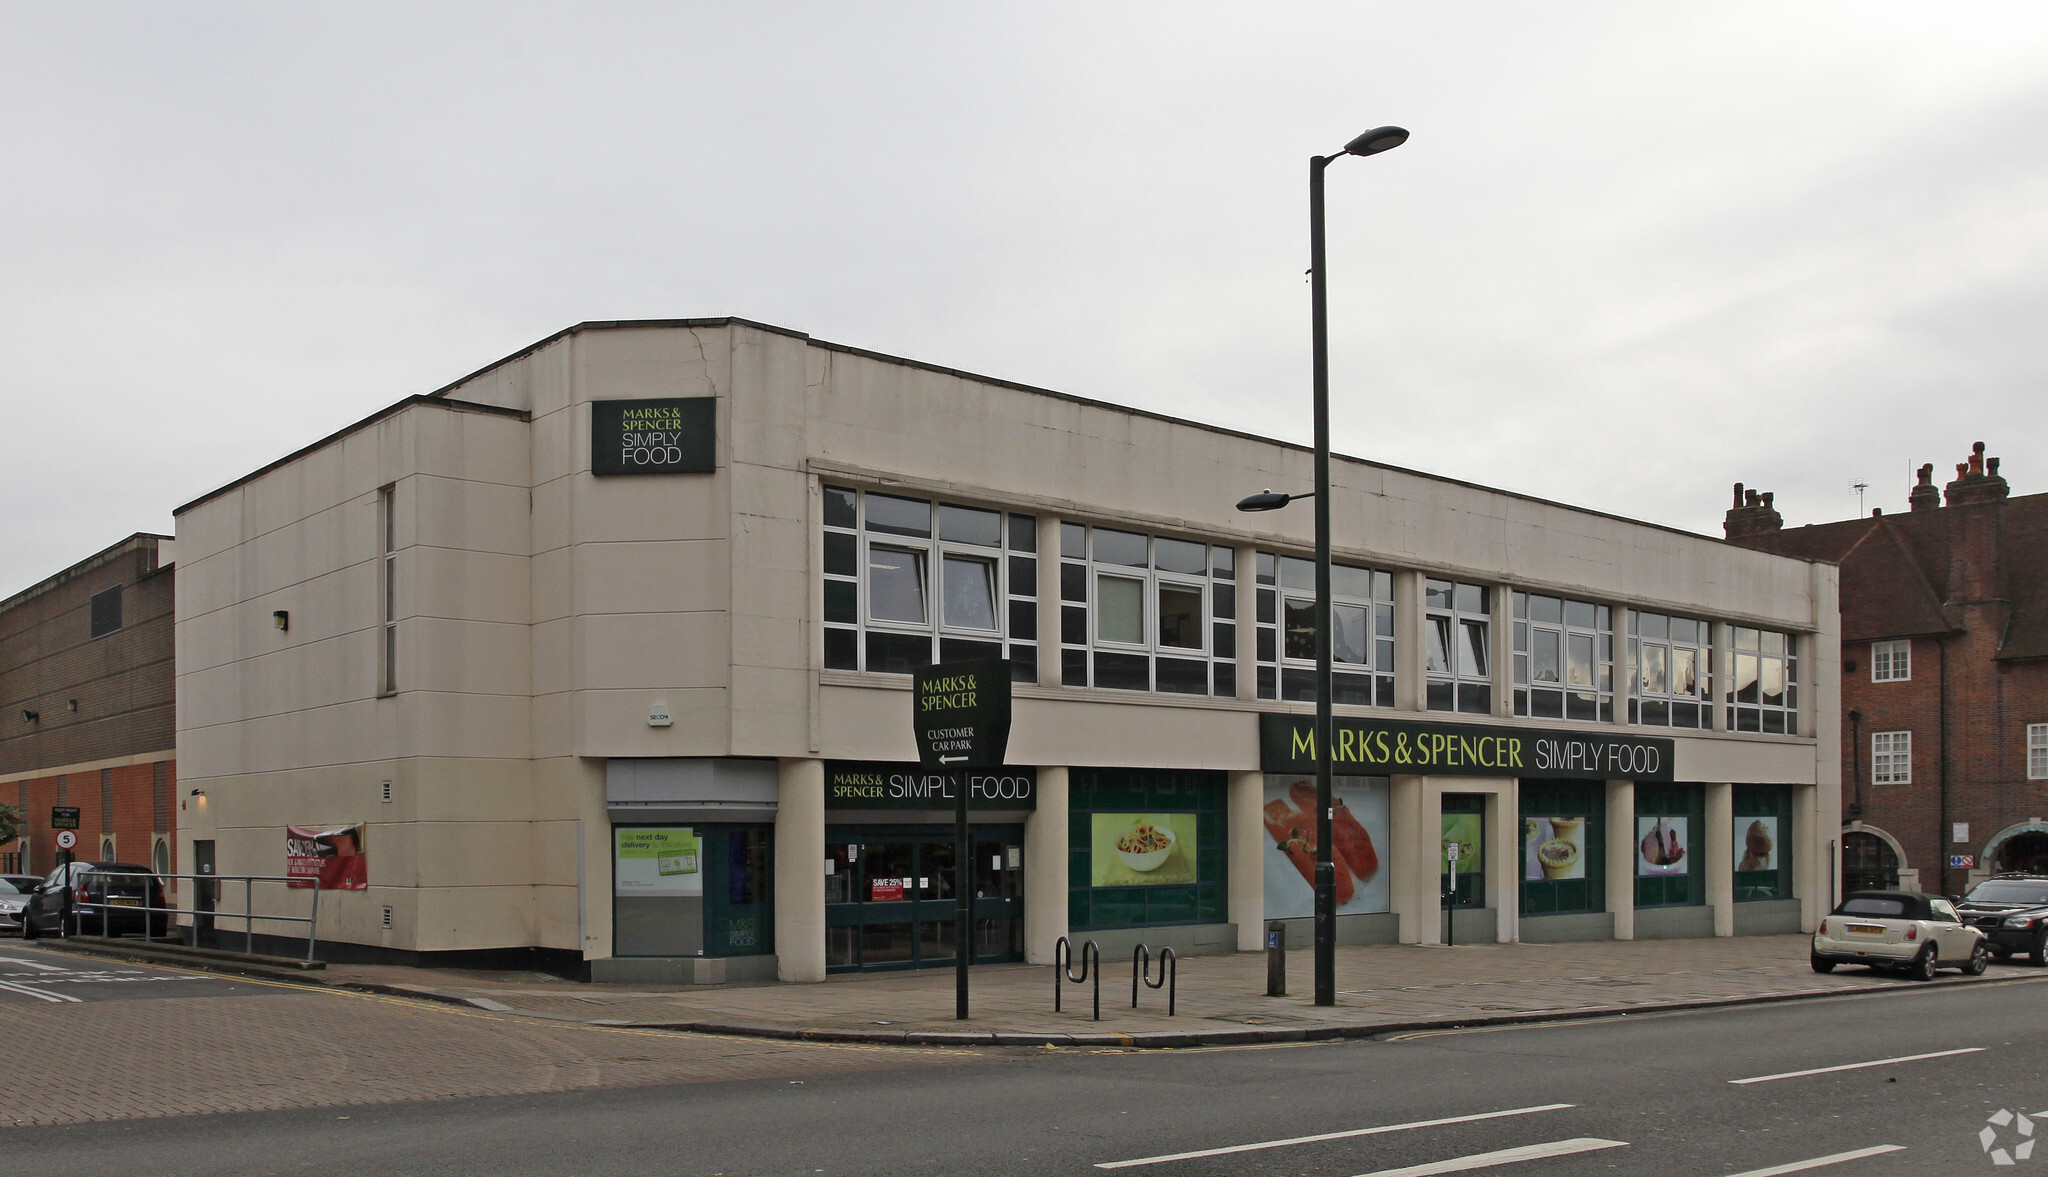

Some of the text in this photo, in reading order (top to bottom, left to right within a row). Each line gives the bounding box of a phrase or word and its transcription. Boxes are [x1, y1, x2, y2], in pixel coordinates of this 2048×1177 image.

[622, 407, 681, 419] MARKS &
[622, 419, 682, 431] SPENCER
[622, 432, 681, 447] SIMPLY
[622, 447, 682, 465] FOOD
[921, 691, 977, 711] SPENCER
[927, 727, 974, 740] CUSTOMER
[932, 739, 972, 751] CAR PARK
[1417, 733, 1524, 767] SPENCER
[1535, 739, 1603, 771] SIMPLY
[1608, 743, 1660, 773] FOOD
[834, 786, 884, 798] SPENCER
[971, 776, 1030, 799] FOOD
[63, 835, 70, 844] 5
[655, 833, 668, 841] day
[621, 841, 650, 849] delivery
[889, 878, 902, 886] 25%
[729, 937, 755, 946] FOOD
